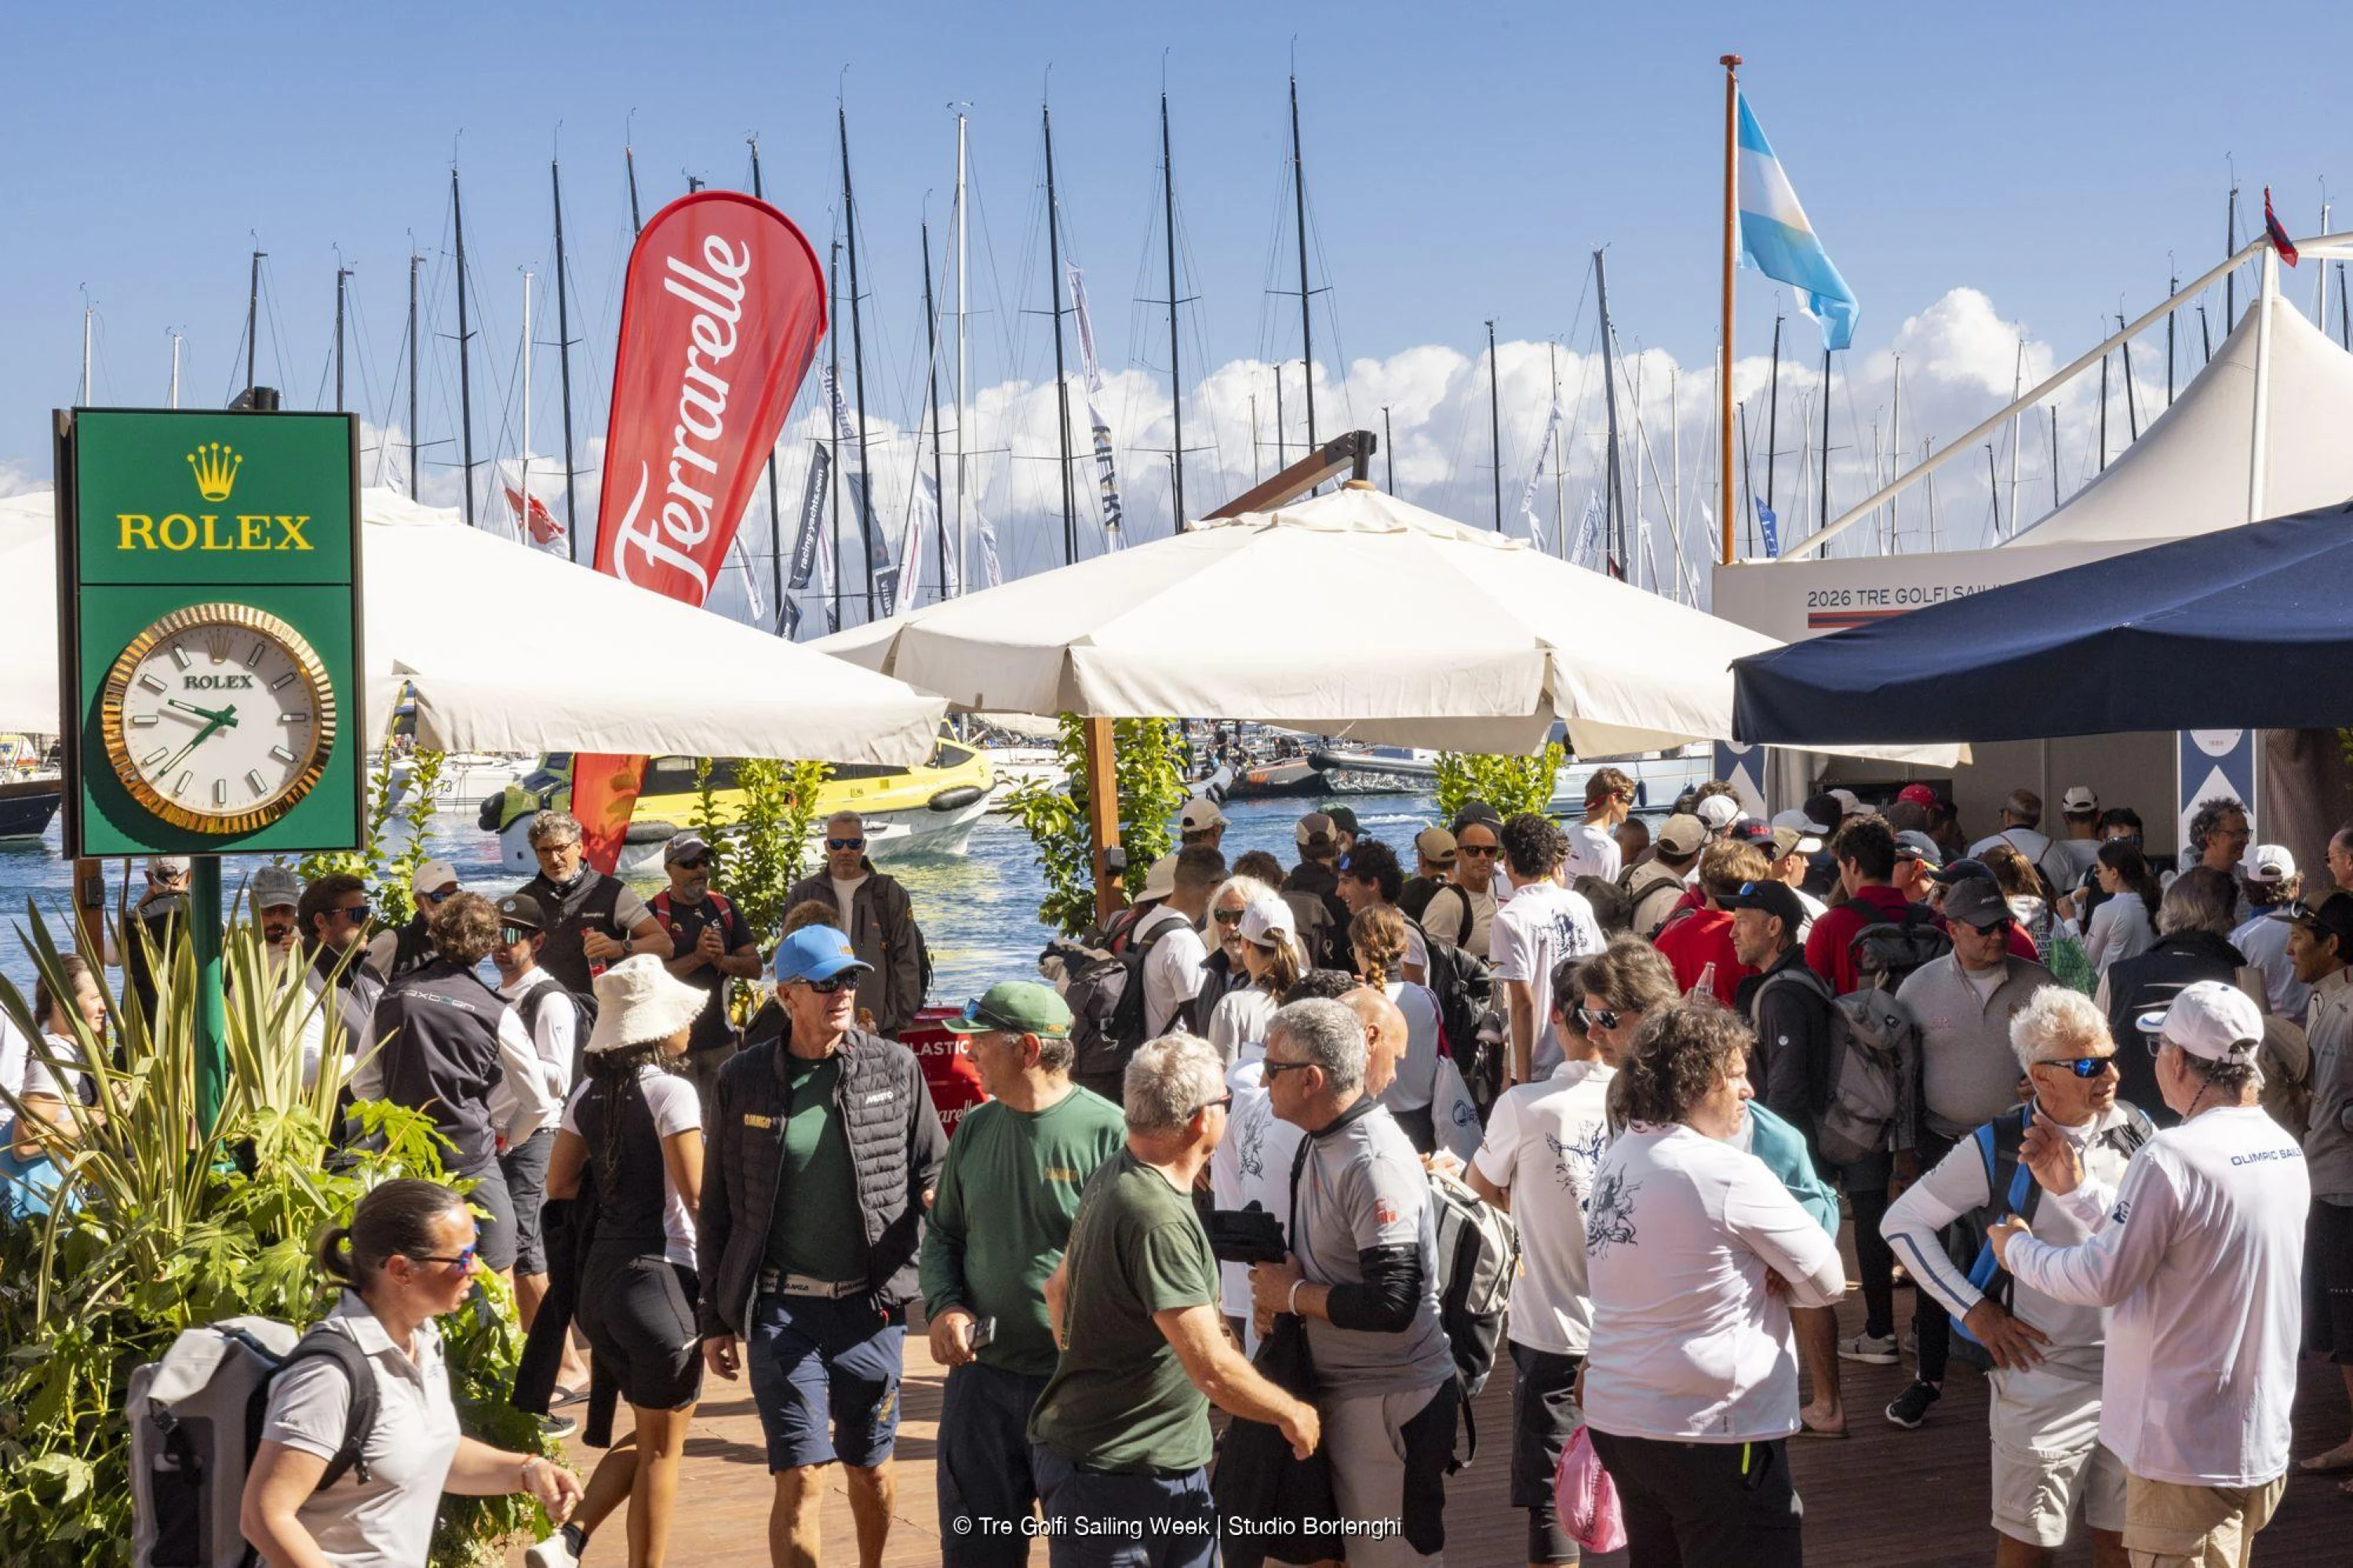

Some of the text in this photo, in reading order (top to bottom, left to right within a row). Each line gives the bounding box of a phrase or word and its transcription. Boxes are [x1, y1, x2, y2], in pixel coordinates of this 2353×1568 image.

[614, 235, 751, 609] Ferrarelle
[800, 469, 823, 570] racing-yachts.com
[116, 514, 314, 551] ROLEX
[1808, 590, 1852, 607] 2026
[1857, 589, 1890, 606] TRE
[1896, 587, 1948, 604] GOLFI
[184, 675, 254, 690] ROLEX
[901, 1039, 971, 1057] LASTIC
[2230, 1151, 2278, 1166] OLIMPIC
